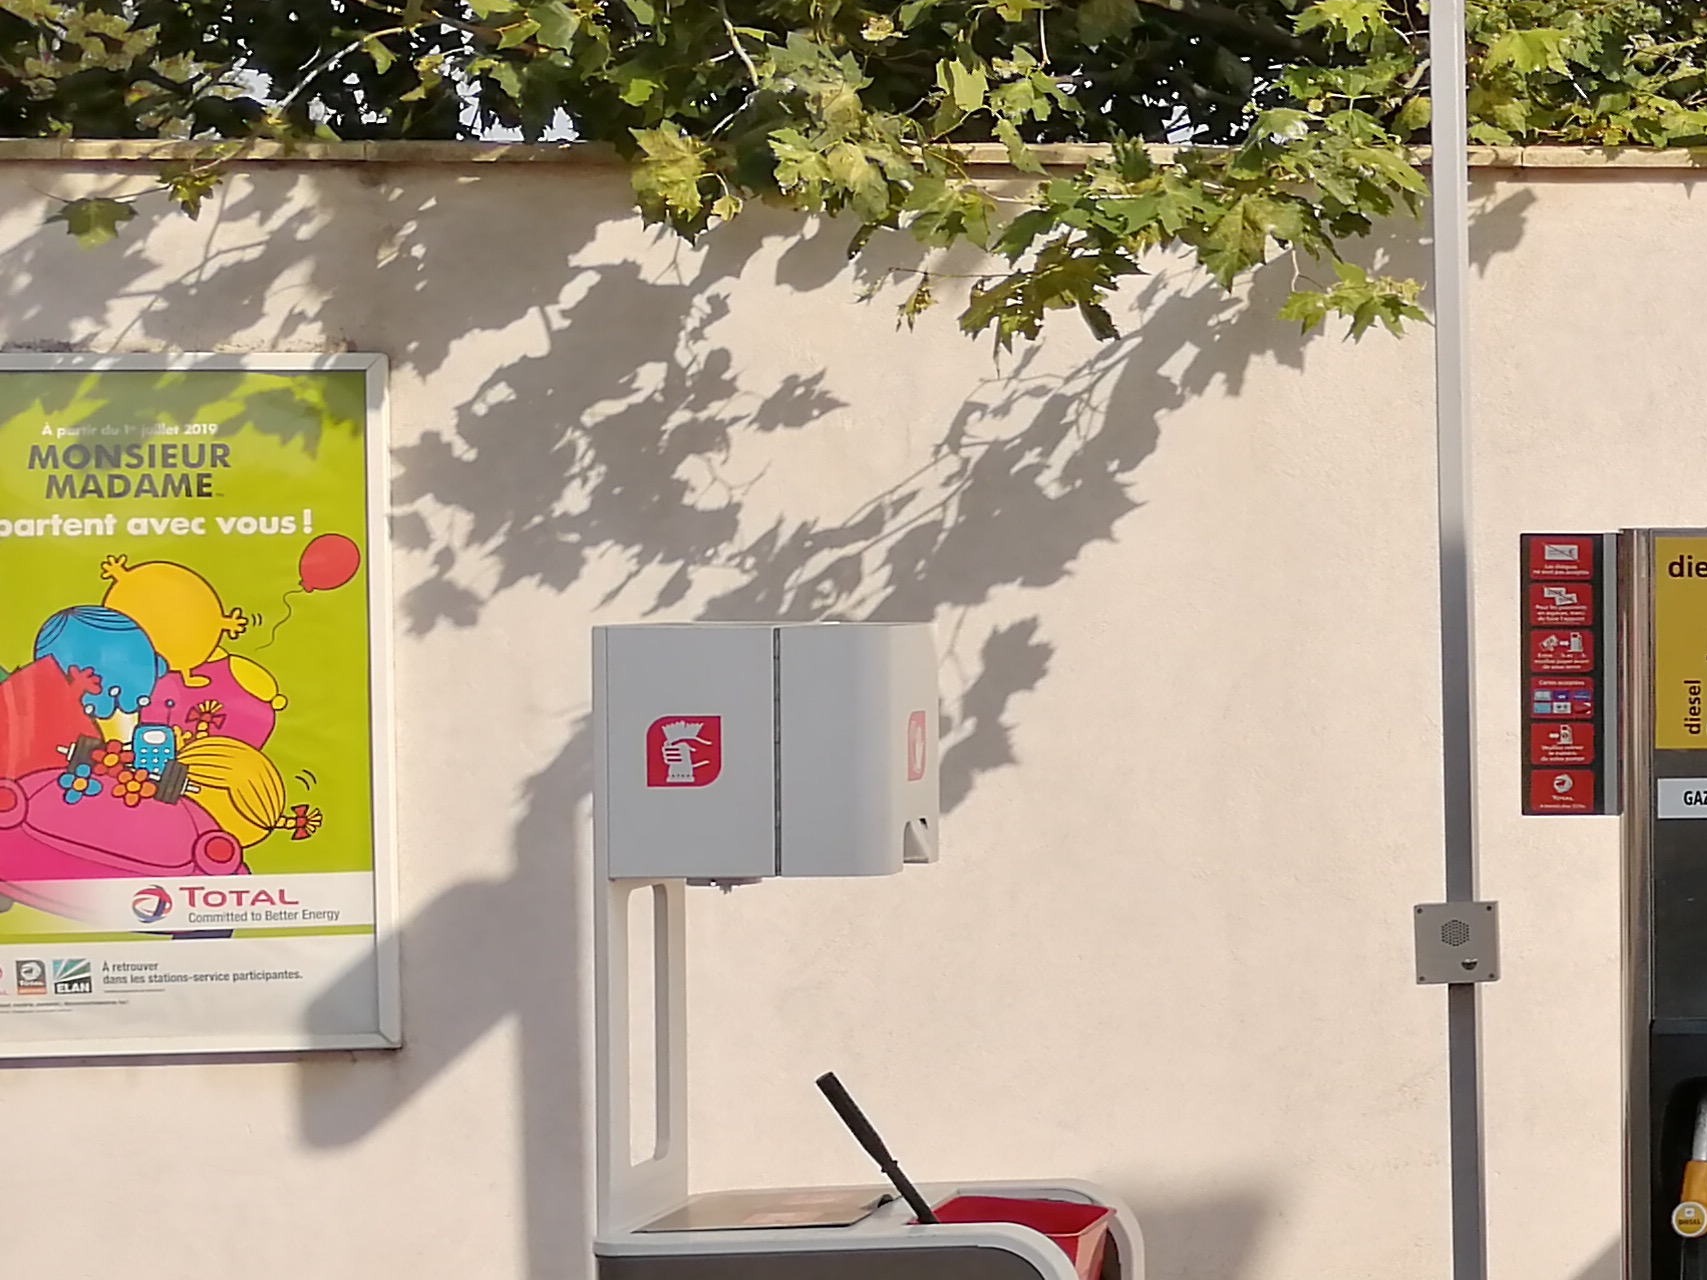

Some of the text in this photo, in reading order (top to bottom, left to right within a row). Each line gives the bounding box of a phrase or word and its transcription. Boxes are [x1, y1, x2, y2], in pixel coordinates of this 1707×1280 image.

[41, 422, 53, 436] À
[57, 424, 96, 438] partir
[101, 424, 118, 436] du
[141, 423, 179, 438] juillet
[184, 423, 218, 436] 2019
[28, 443, 231, 470] MONSIEUR
[45, 473, 213, 499] MADAME
[126, 517, 206, 535] avec
[1684, 679, 1701, 734] diesel
[179, 886, 299, 908] TOTAL
[188, 909, 340, 923] Committed to Better Energy
[112, 962, 158, 972] retrouver
[103, 970, 303, 987] dans les stations-service participantes.
[56, 982, 90, 993] ELAN
